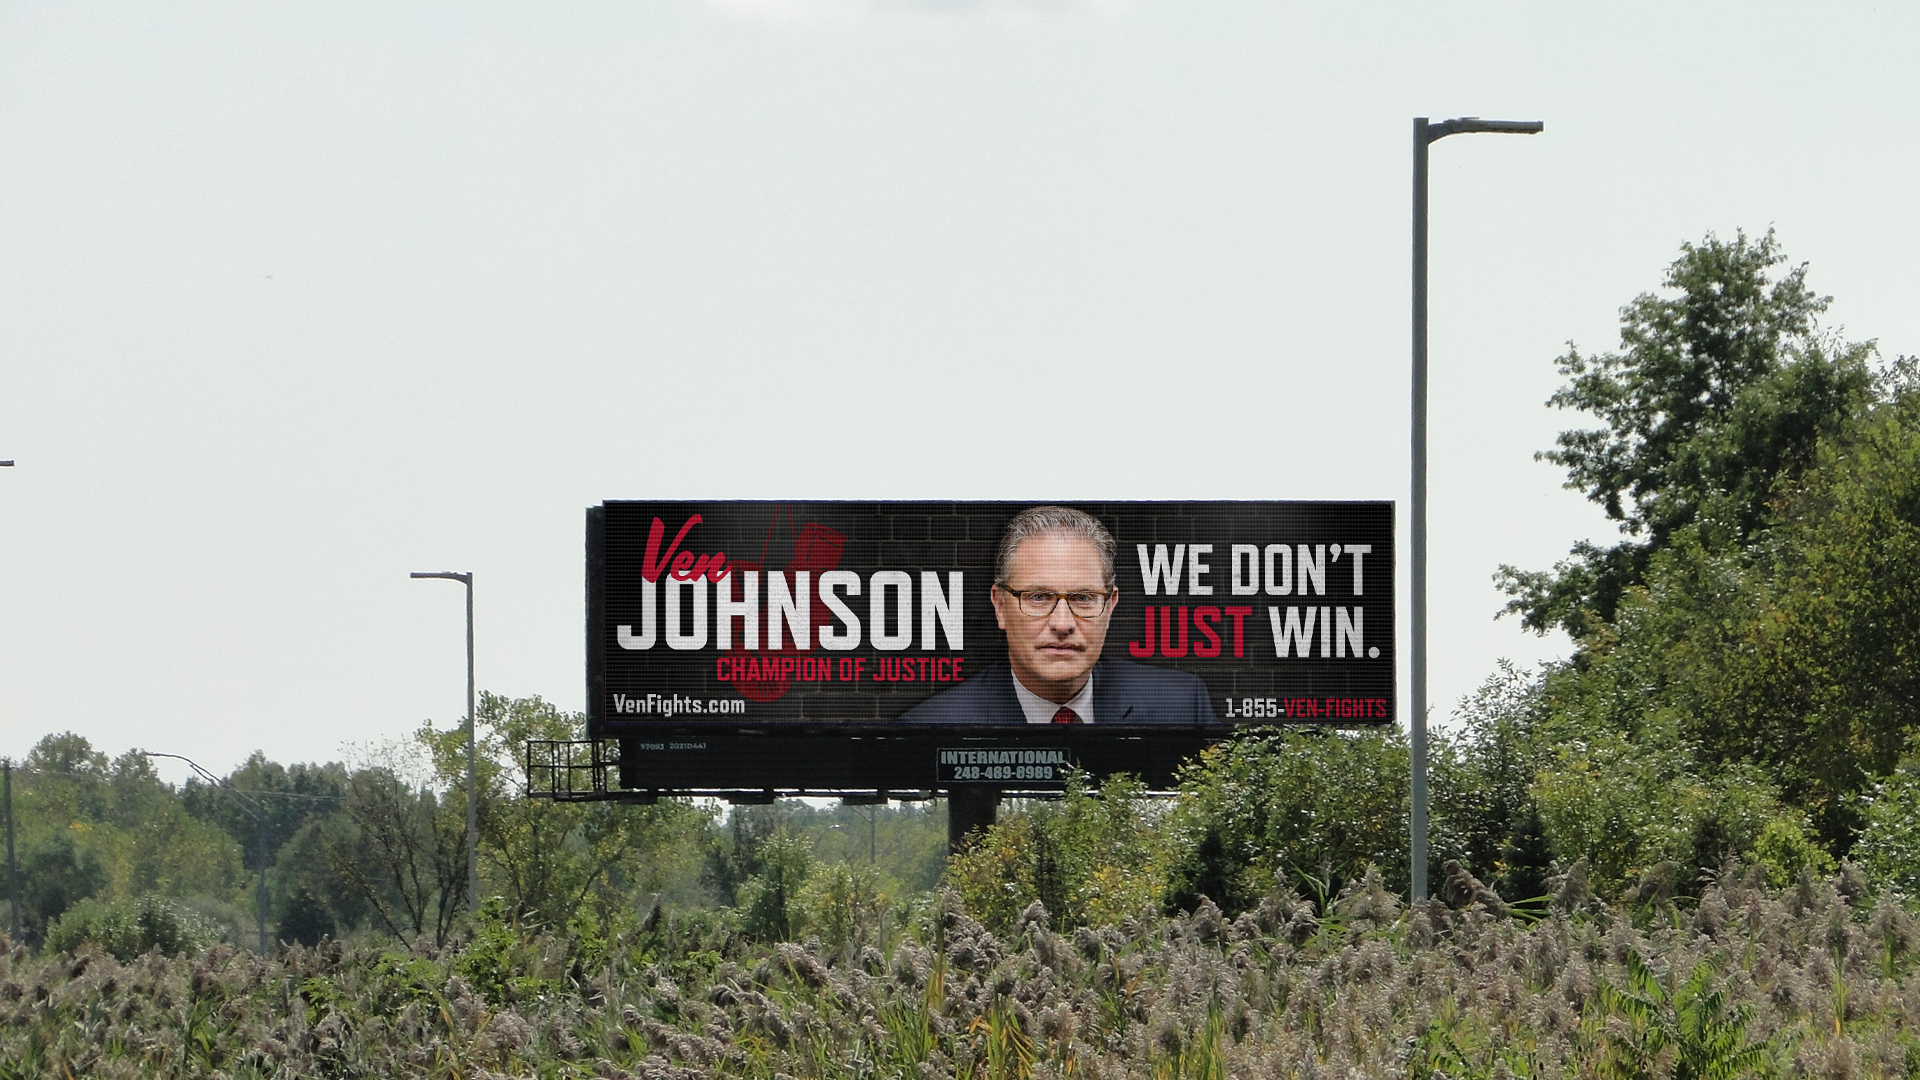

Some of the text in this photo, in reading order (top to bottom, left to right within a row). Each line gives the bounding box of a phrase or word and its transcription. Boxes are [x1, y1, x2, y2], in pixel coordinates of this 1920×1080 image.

[641, 514, 732, 584] Ven
[1137, 543, 1372, 596] WE DON'T
[617, 571, 964, 651] JOHNSON
[1129, 606, 1380, 659] JUST WIN.
[717, 657, 965, 682] CHAMPION OF JUSTICE
[613, 693, 746, 717] VenFights.com
[1225, 698, 1387, 718] 1-855-VEN-FIGHTS
[941, 750, 1066, 765] INTERNATIONAL
[953, 765, 1053, 780] 248-489-8989
